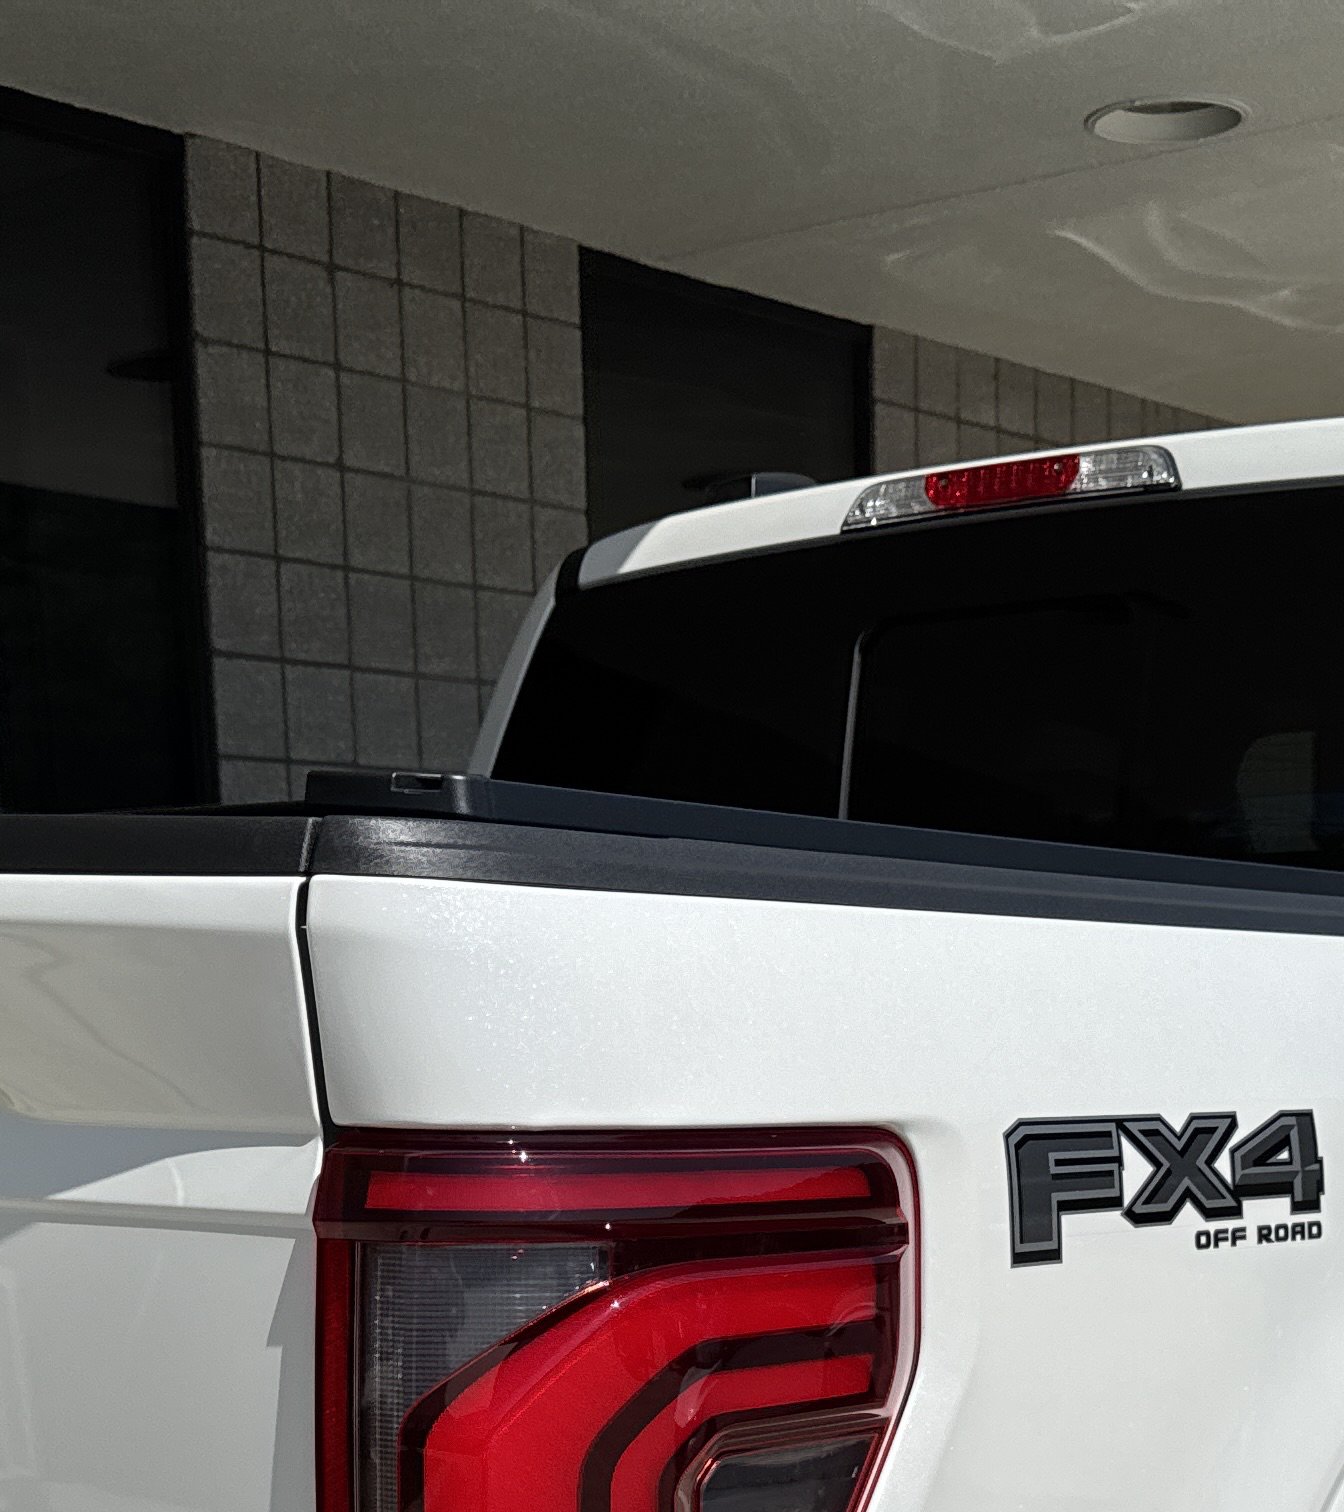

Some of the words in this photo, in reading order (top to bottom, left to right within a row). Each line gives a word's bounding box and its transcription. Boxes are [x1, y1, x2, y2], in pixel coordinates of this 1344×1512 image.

[1003, 1109, 1325, 1268] FX4
[1194, 1226, 1248, 1251] OFF
[1256, 1220, 1323, 1245] ROAD
